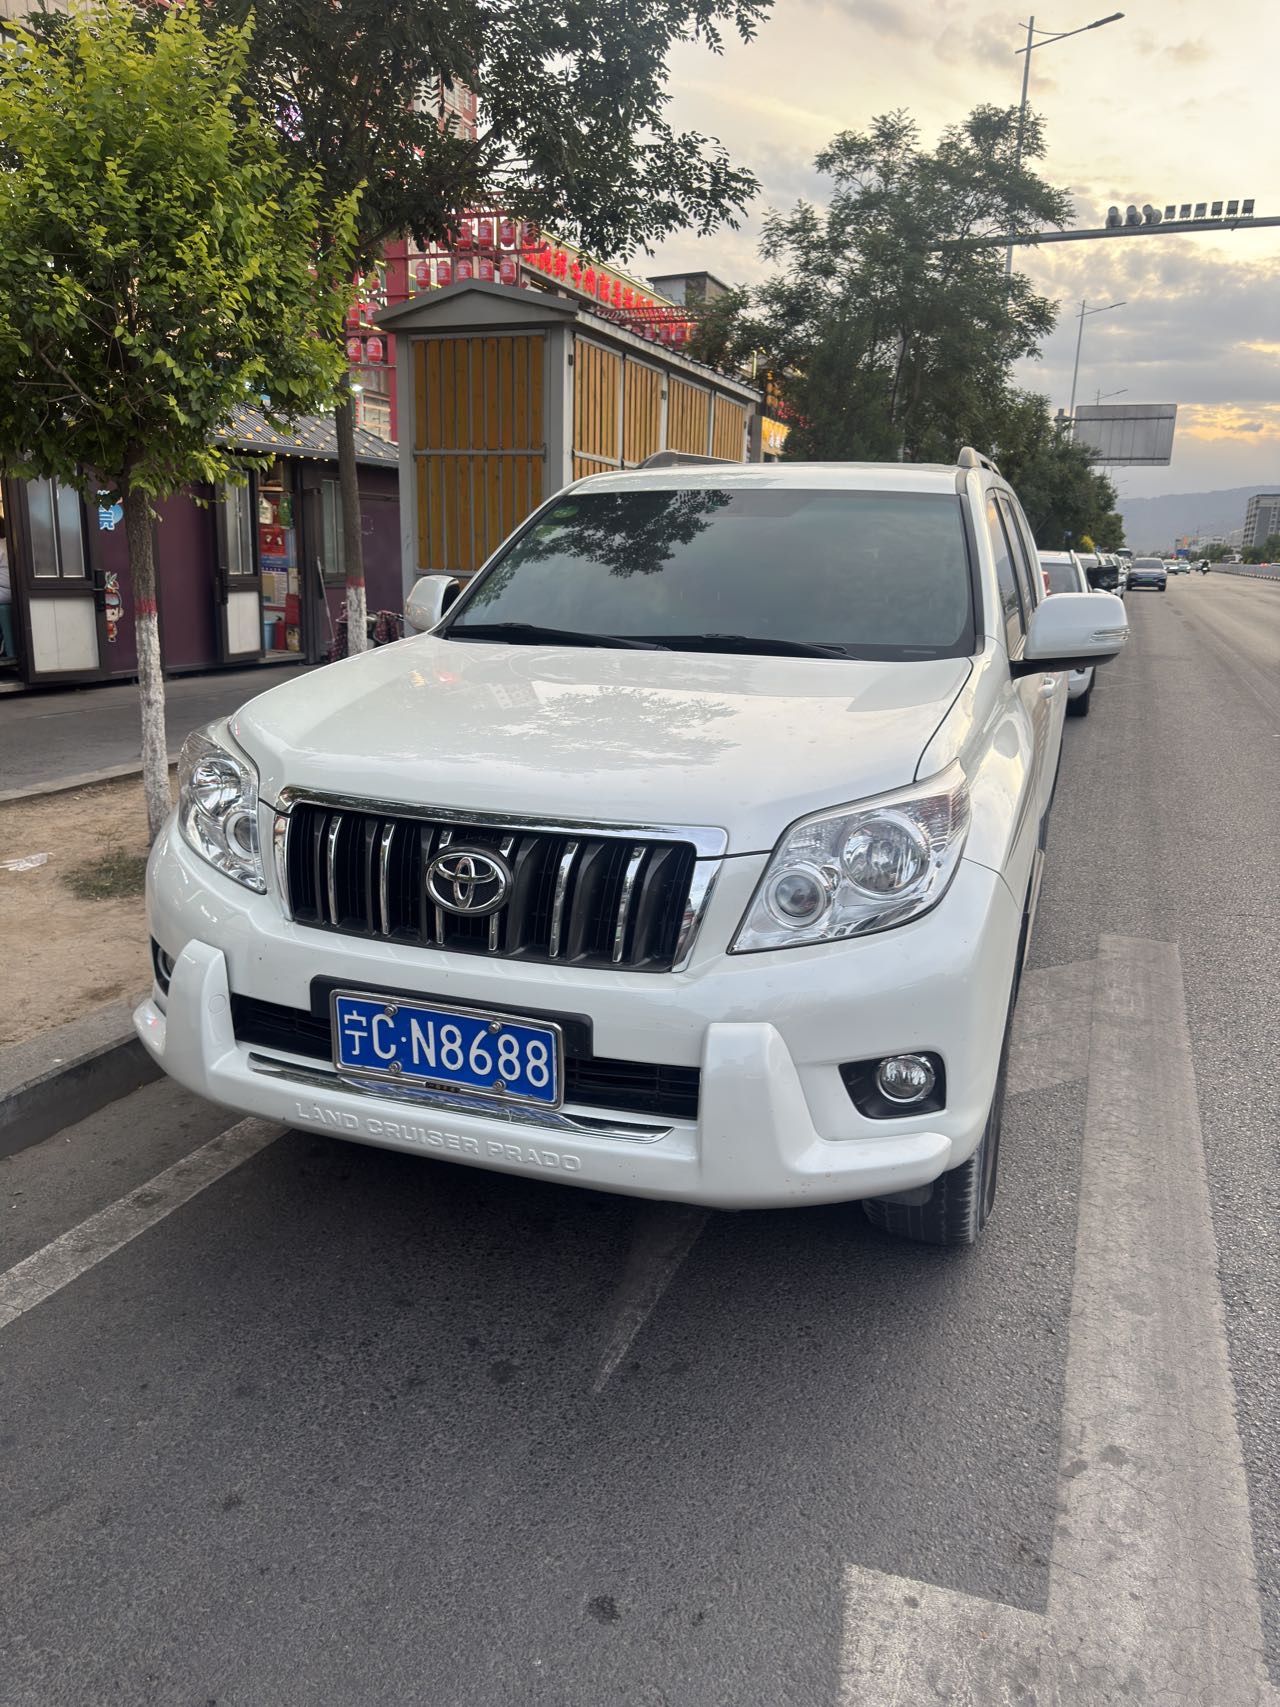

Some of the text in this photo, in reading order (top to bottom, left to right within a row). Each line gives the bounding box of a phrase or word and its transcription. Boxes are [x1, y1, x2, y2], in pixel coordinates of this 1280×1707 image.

[295, 1102, 581, 1172] LAND CRUISER PRADO
